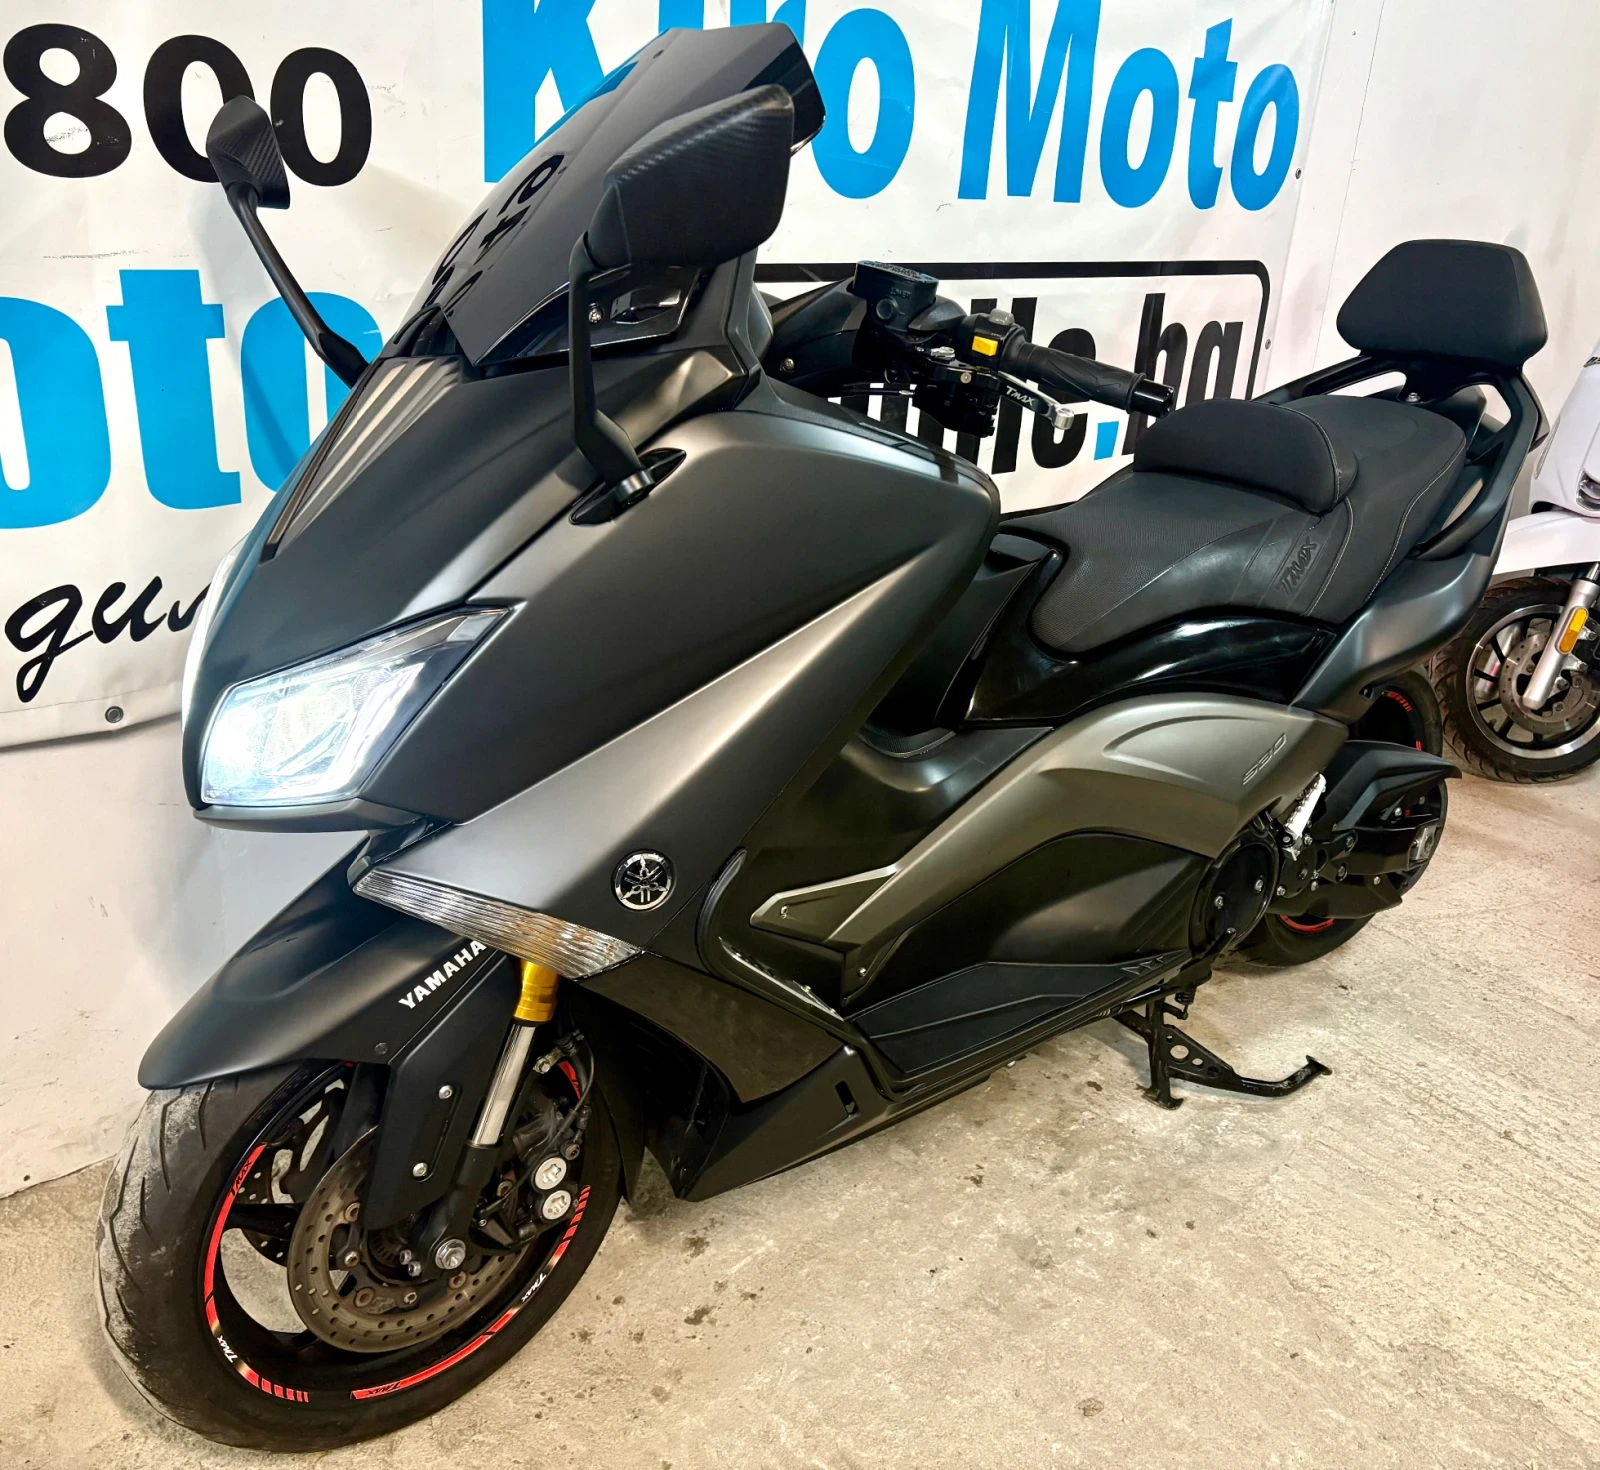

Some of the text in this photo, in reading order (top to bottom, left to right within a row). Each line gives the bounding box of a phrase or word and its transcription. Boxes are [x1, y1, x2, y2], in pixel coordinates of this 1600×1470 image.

[958, 0, 1302, 211] Moto
[1006, 385, 1035, 406] TMAX
[1275, 536, 1318, 595] TMAX
[398, 940, 487, 1009] YAMAHA
